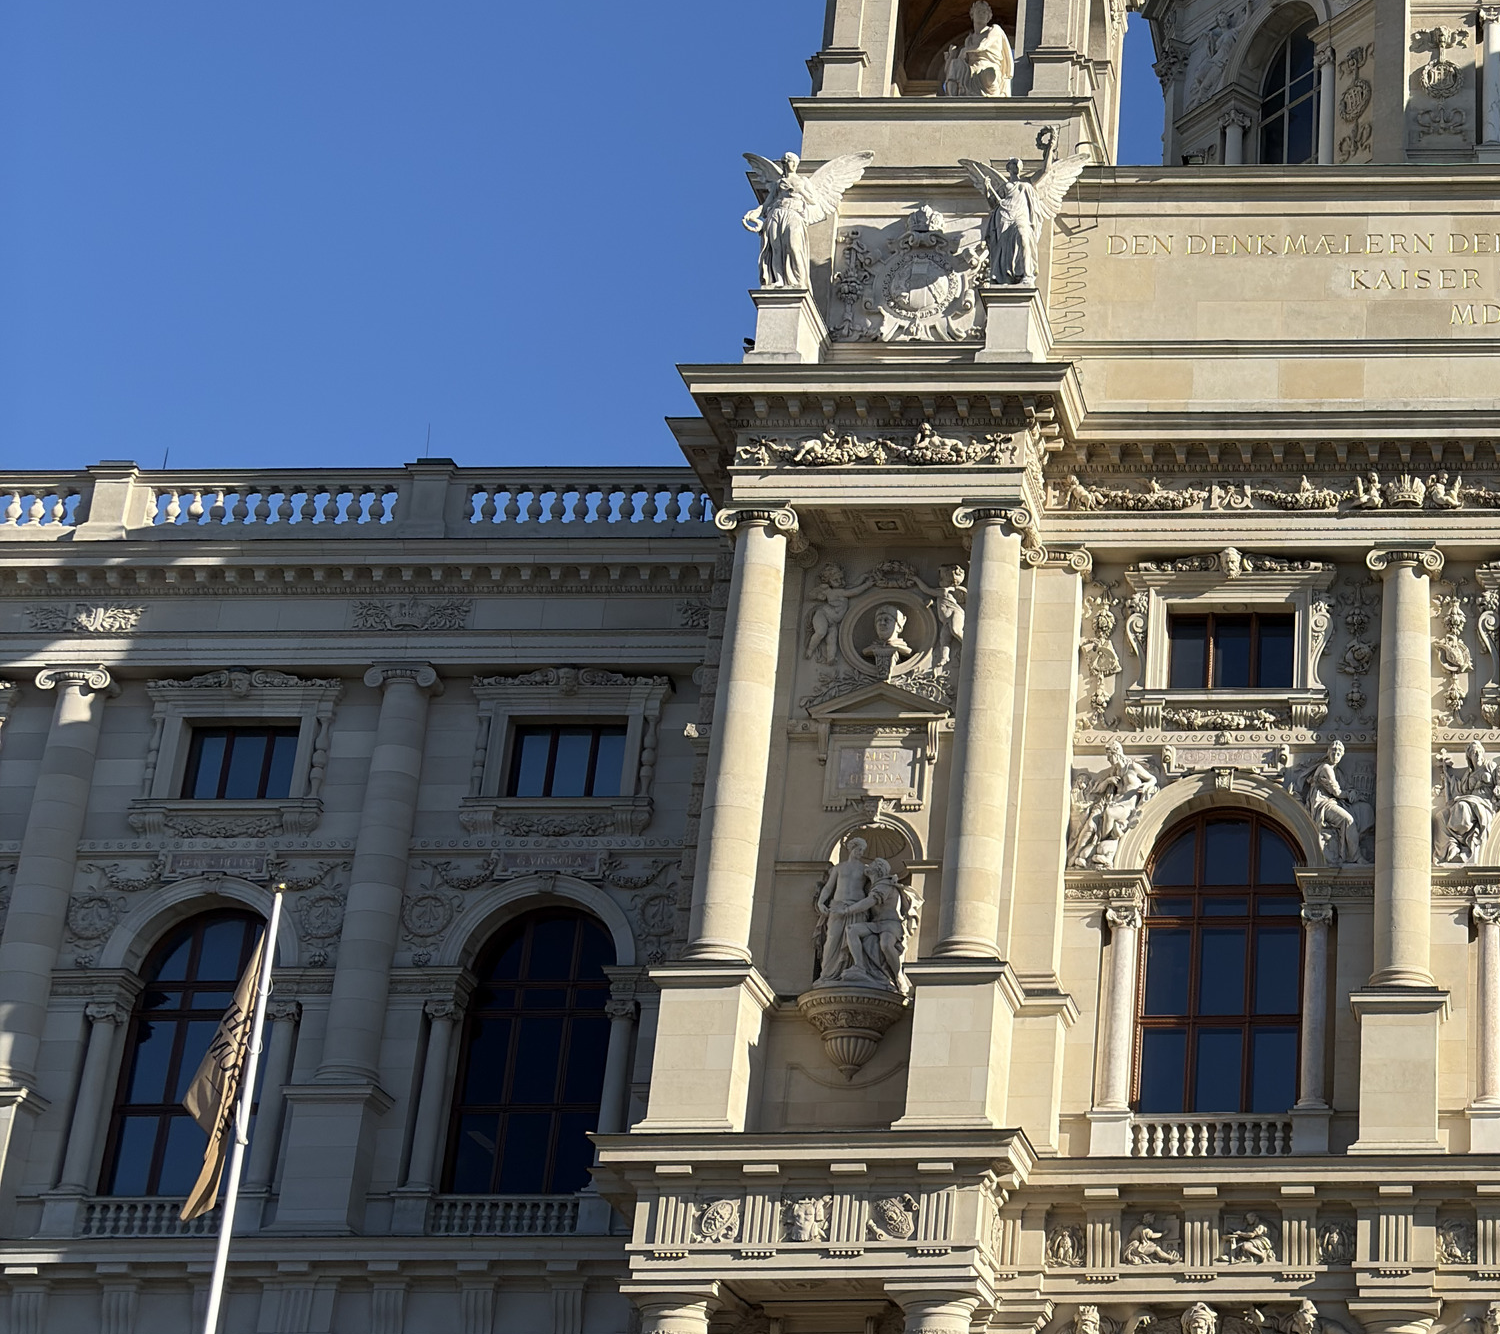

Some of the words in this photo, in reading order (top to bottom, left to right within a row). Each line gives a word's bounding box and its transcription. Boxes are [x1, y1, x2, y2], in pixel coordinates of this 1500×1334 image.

[1106, 234, 1174, 255] DEN
[1185, 232, 1434, 256] DENKMÆLERN
[1350, 268, 1483, 290] KAISER
[856, 750, 900, 762] FAUST
[849, 773, 904, 784] HELENA
[530, 855, 583, 866] VIGNOLA
